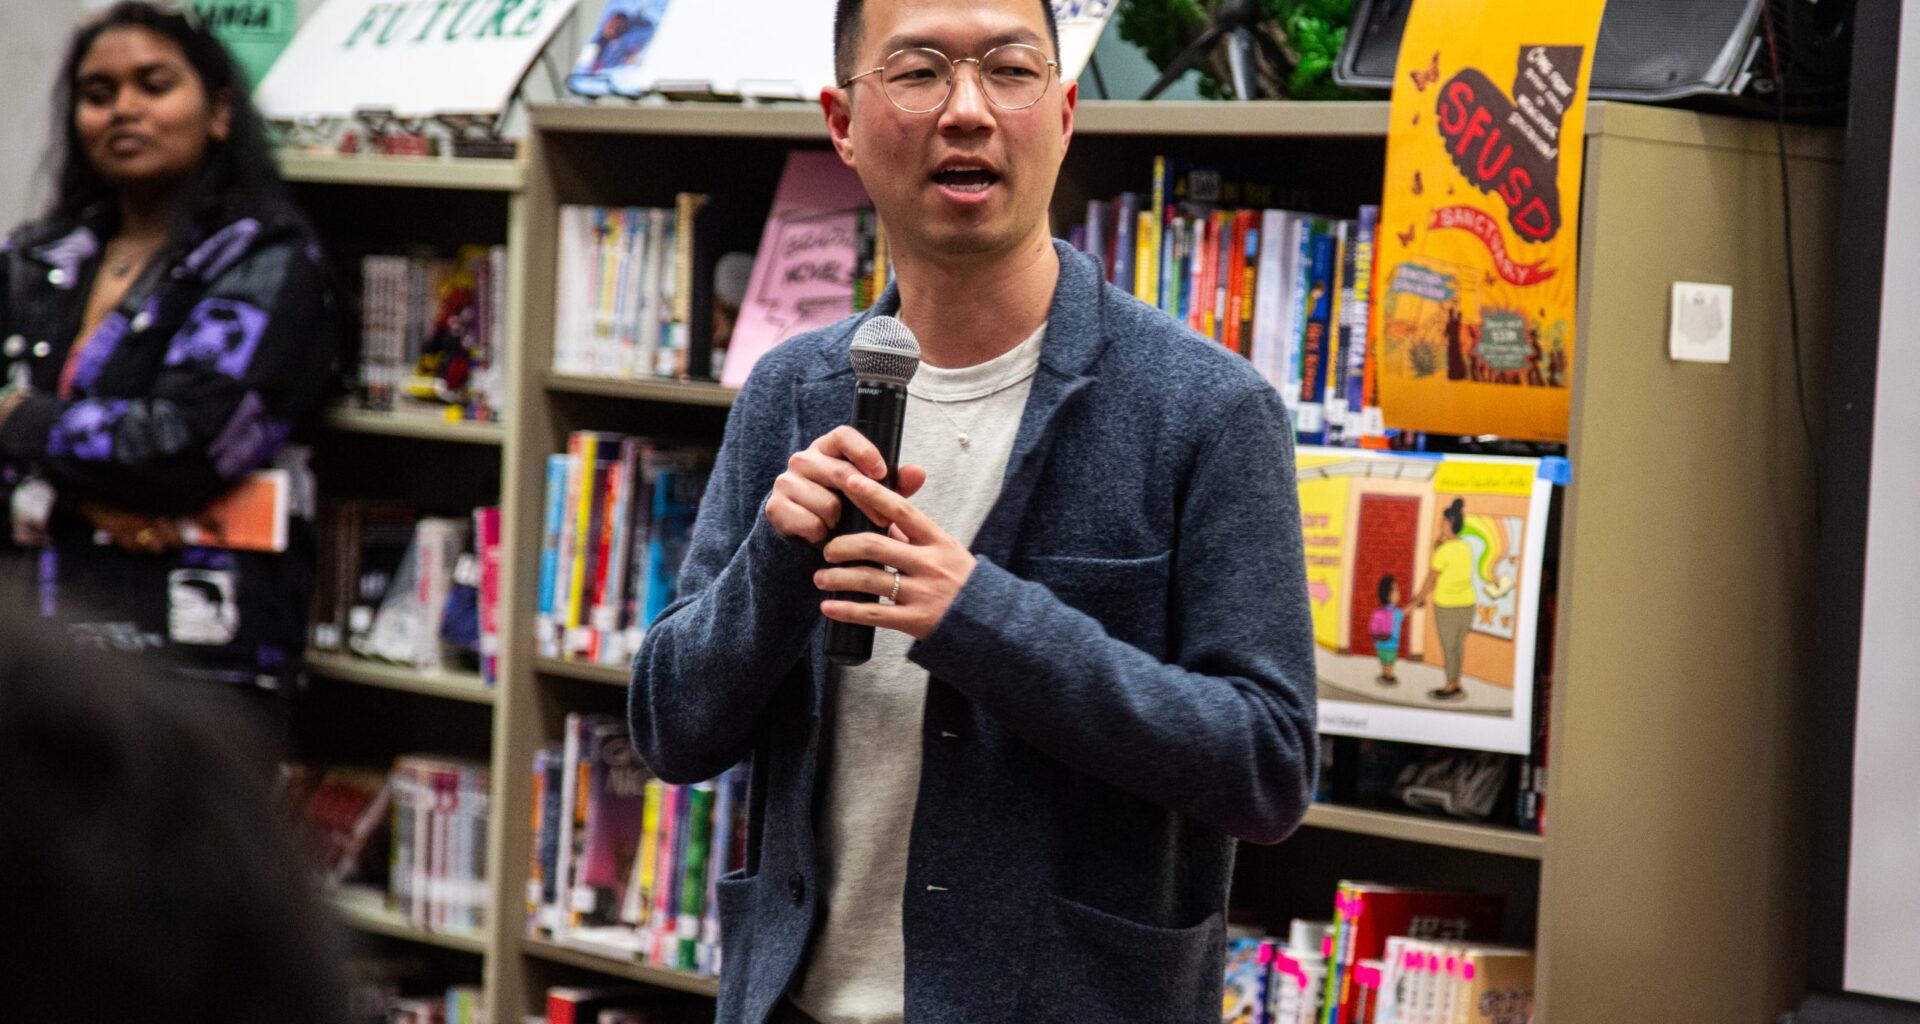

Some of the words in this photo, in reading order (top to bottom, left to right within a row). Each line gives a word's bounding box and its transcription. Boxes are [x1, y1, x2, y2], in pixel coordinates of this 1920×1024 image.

[343, 0, 542, 47] FUTURE
[1439, 81, 1551, 237] SFUSD
[1440, 206, 1529, 283] SANCTUARY
